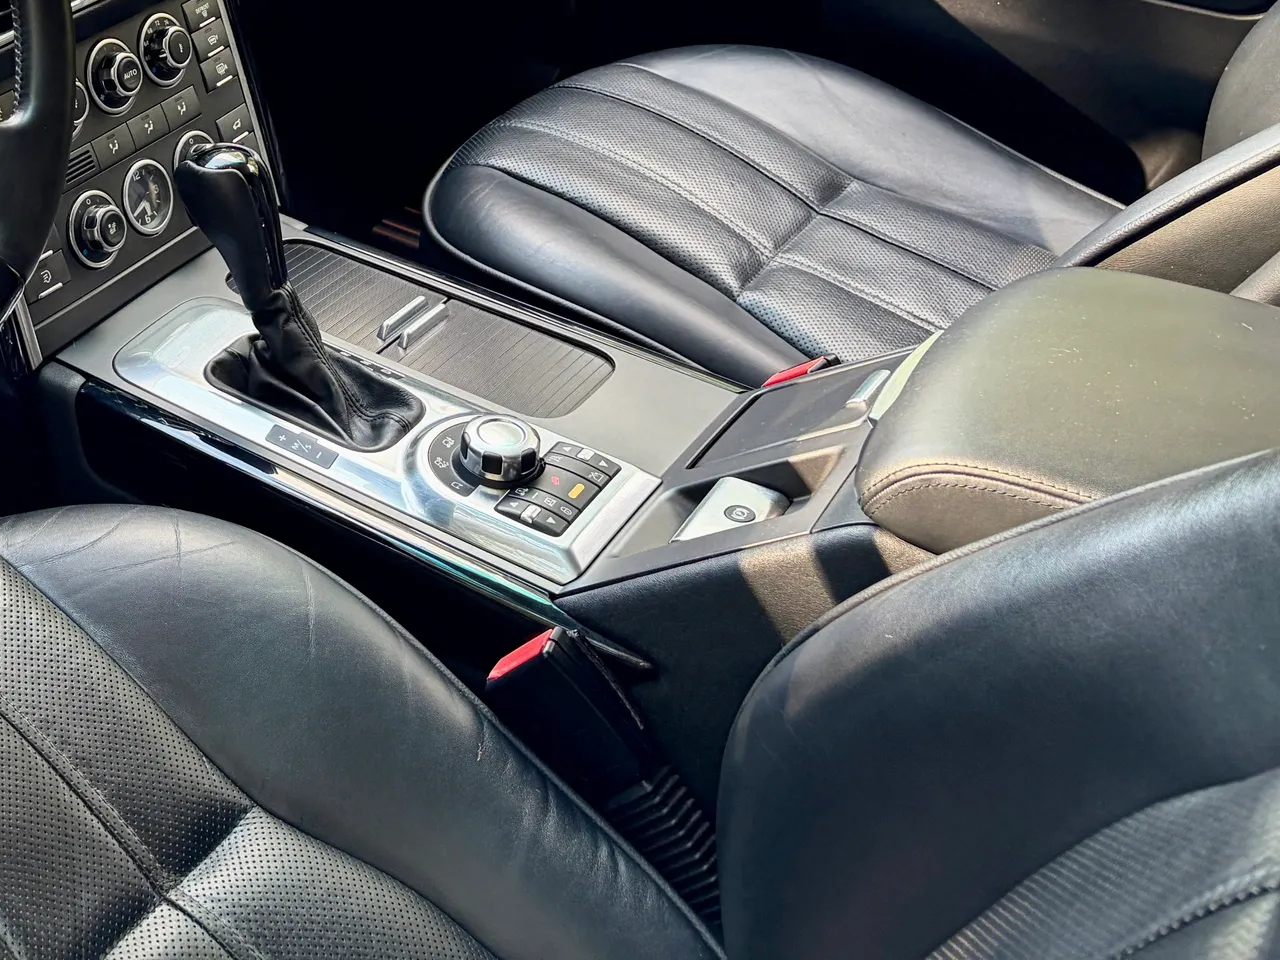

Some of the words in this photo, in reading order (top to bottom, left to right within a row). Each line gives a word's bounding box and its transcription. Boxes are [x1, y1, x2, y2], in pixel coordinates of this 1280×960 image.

[124, 68, 138, 79] AUTO
[132, 170, 141, 181] 12
[145, 214, 151, 224] 6
